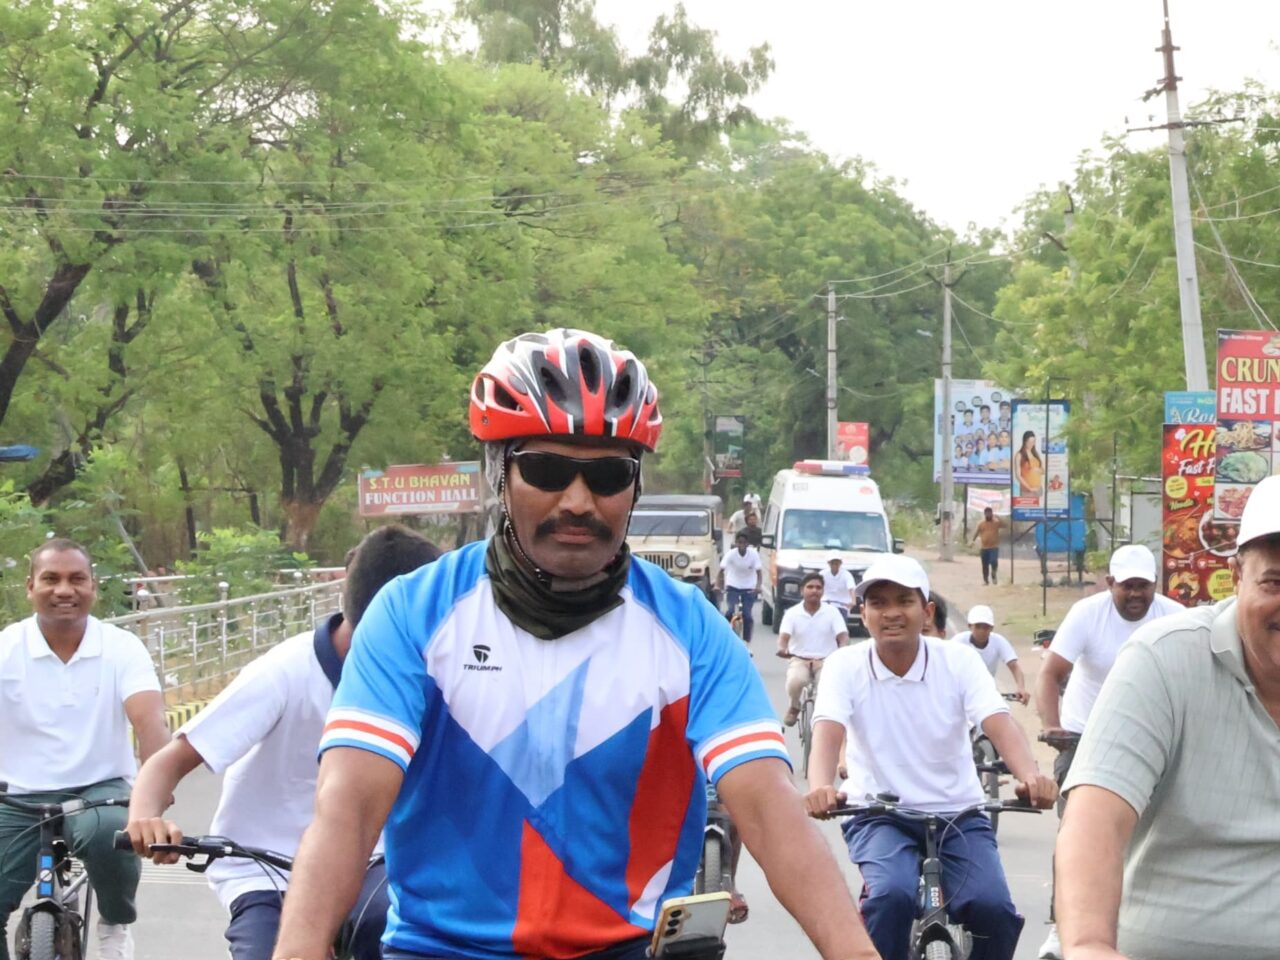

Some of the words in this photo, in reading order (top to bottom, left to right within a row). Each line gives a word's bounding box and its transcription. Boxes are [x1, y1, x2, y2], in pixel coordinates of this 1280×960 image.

[1220, 388, 1269, 415] FAST
[1178, 458, 1205, 476] Fast
[409, 474, 471, 488] BHAVAN
[365, 490, 435, 504] FUNCTION
[441, 488, 479, 501] HALL
